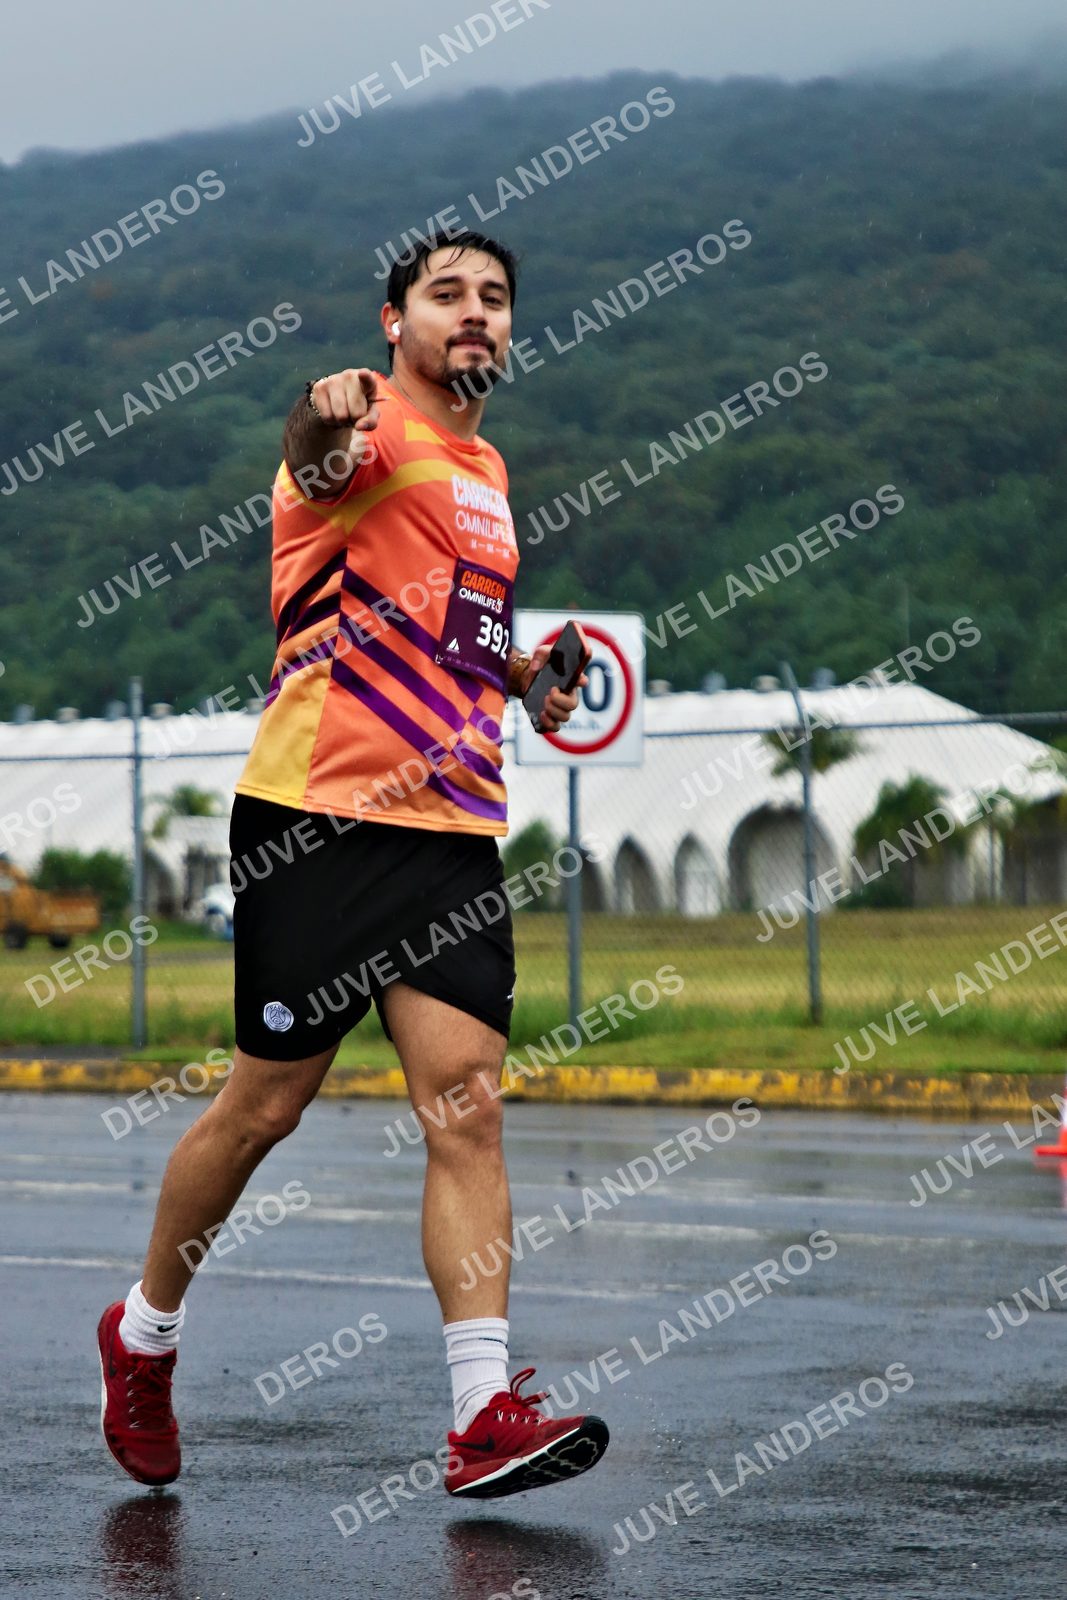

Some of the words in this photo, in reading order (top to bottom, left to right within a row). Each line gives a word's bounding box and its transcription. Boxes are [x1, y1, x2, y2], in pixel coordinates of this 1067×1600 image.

[459, 587, 496, 611] OMNILIFE
[461, 570, 506, 600] CARRERA
[582, 658, 614, 712] 0
